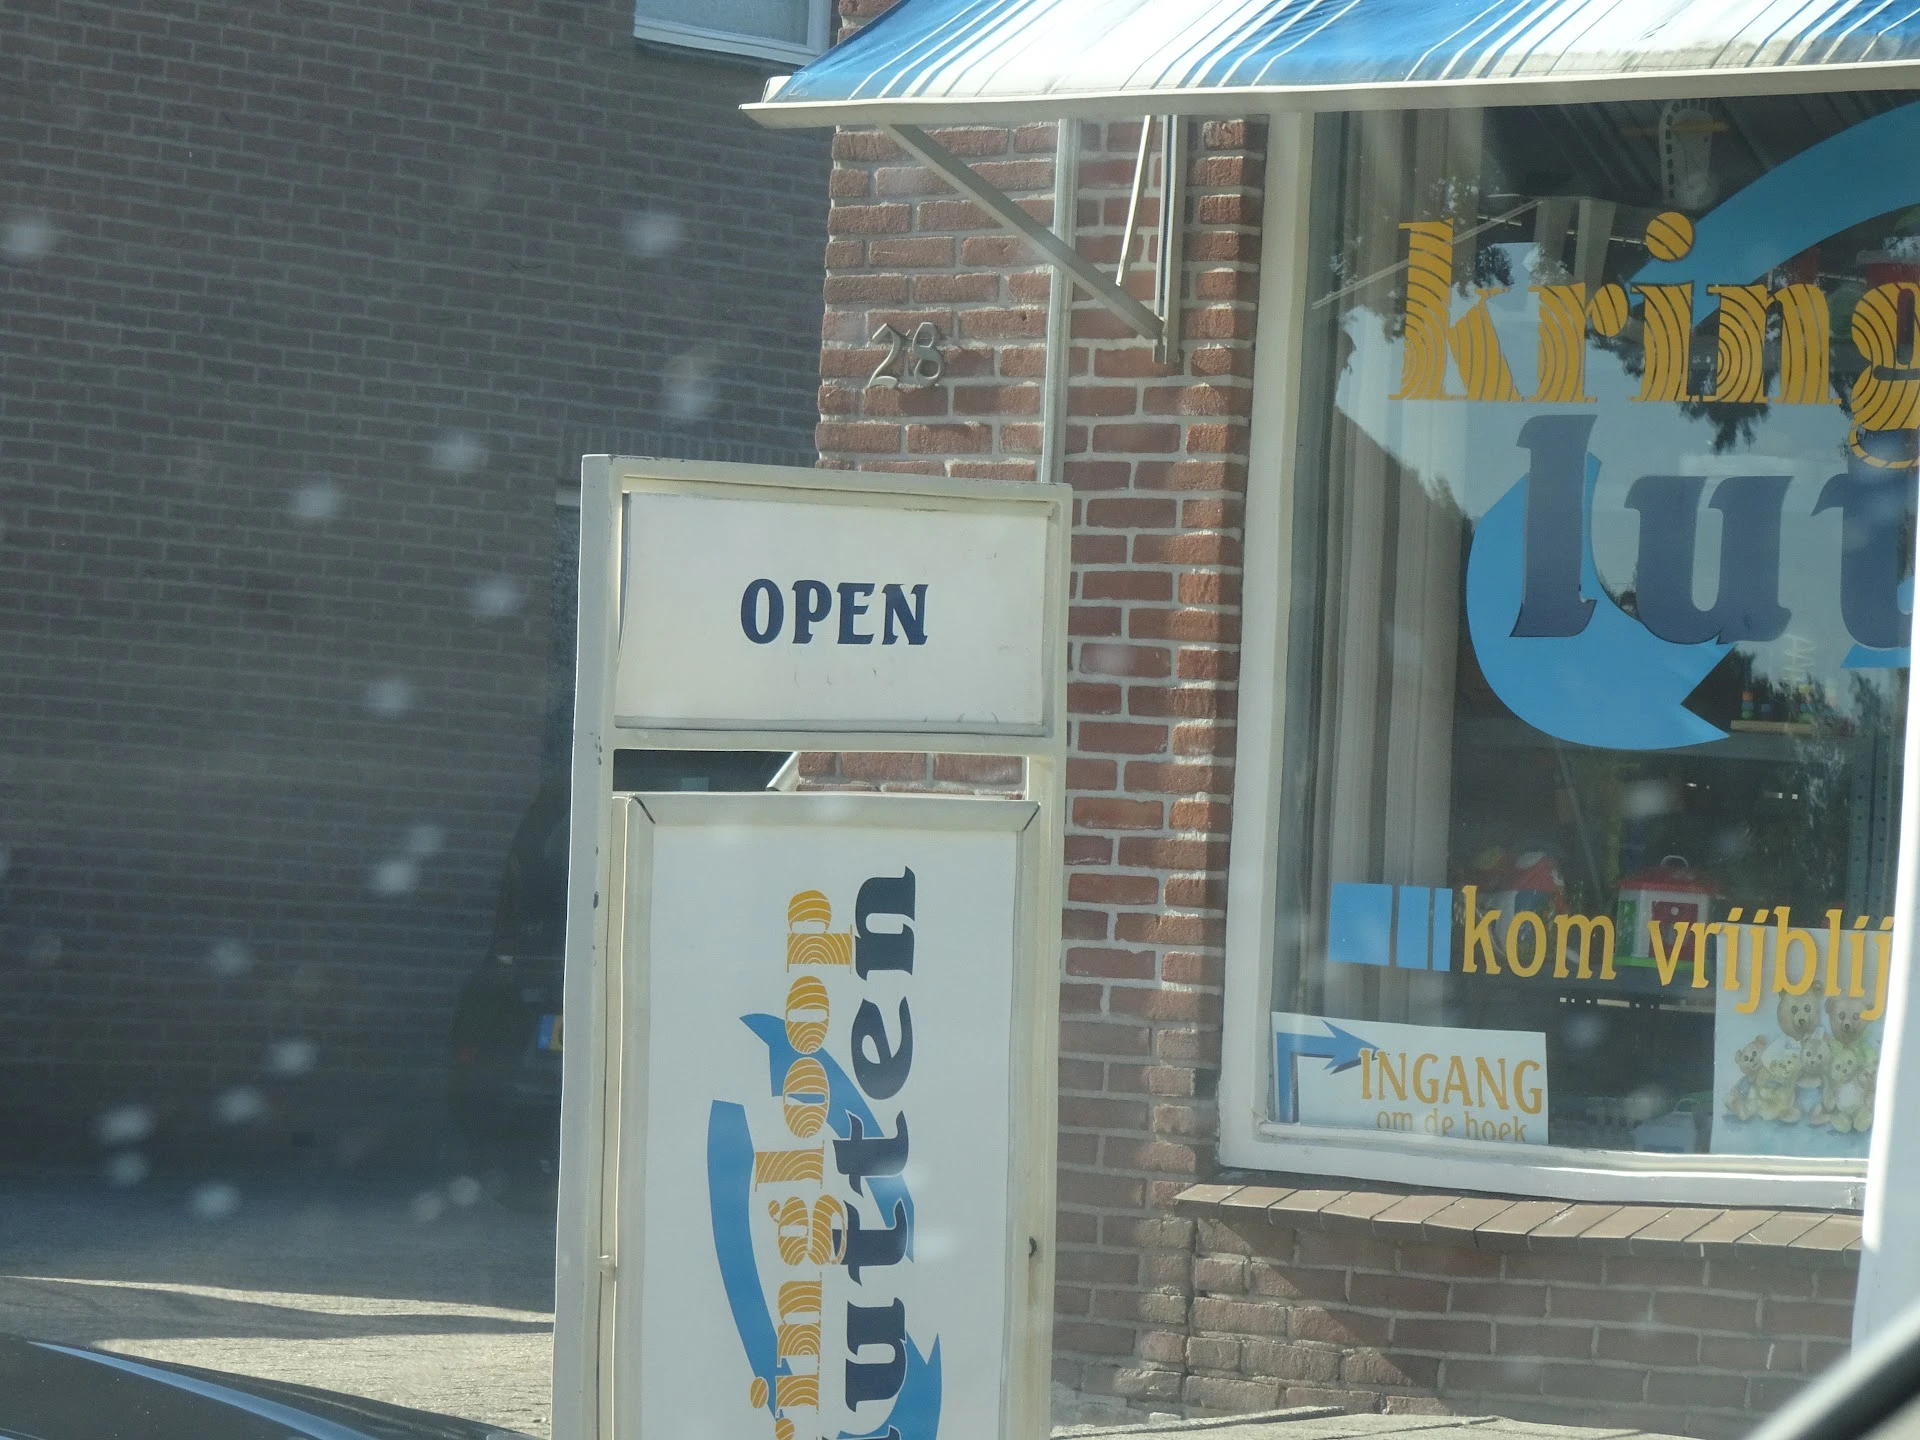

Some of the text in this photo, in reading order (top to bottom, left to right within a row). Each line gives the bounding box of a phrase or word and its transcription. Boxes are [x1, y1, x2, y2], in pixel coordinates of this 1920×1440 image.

[868, 322, 942, 389] 28
[740, 578, 929, 646] OPEN
[1461, 885, 1893, 1021] kom vrijblij
[1359, 1048, 1542, 1114] INGANG
[822, 866, 916, 1440] utten
[1376, 1108, 1527, 1142] om de hoek
[750, 889, 853, 1440] ingloop
